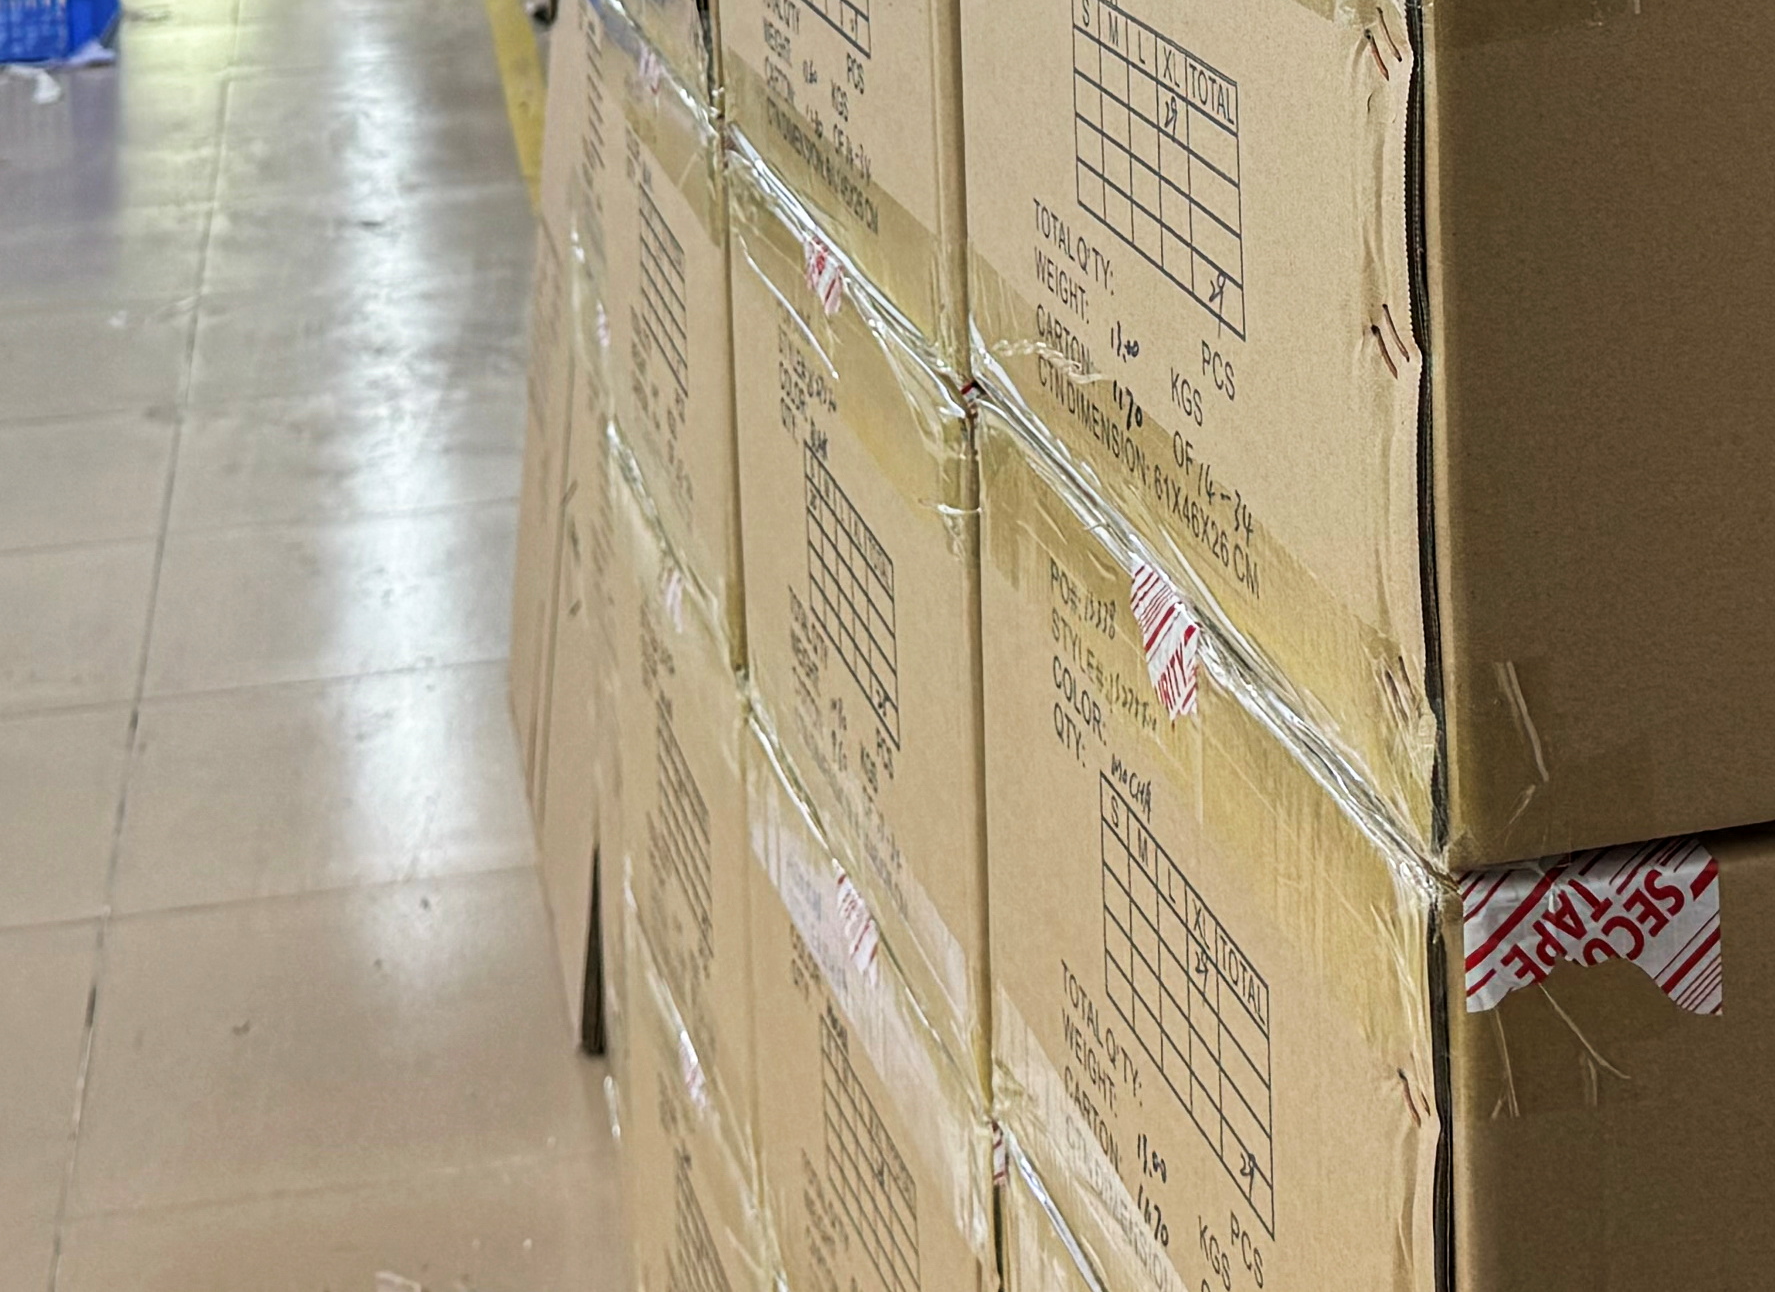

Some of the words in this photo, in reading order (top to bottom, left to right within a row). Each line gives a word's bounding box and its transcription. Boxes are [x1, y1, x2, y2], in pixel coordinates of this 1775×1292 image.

[1108, 11, 1119, 47] M
[1138, 30, 1146, 65] L
[1163, 46, 1180, 89] XL
[1188, 63, 1235, 126] TOTAL
[1033, 197, 1076, 263] TOTAL
[1076, 236, 1115, 296] Q'TY:
[1201, 339, 1236, 401] PCS
[1034, 246, 1090, 324] WEIGHT:
[1171, 367, 1203, 428] KGS
[1067, 382, 1152, 489] DIMENSION:
[1154, 466, 1230, 568] 61X46X26
[1233, 544, 1260, 600] CM
[1173, 431, 1194, 477] OF
[1053, 655, 1106, 746] COLOR:
[1054, 702, 1085, 768] QTY:
[1110, 796, 1120, 829] S
[1137, 826, 1148, 866] M
[1168, 867, 1176, 904] L
[1192, 897, 1210, 951] XL
[1219, 934, 1265, 1026] TOTAL
[1500, 878, 1613, 985] TAPE
[1061, 958, 1104, 1049] TOTAL
[1105, 1028, 1143, 1108] Q'TY:
[1230, 1209, 1264, 1290] PCS
[1062, 1007, 1118, 1118] WEIGHT:
[1198, 1214, 1232, 1292] KGS
[1064, 1066, 1123, 1180] CARTON:
